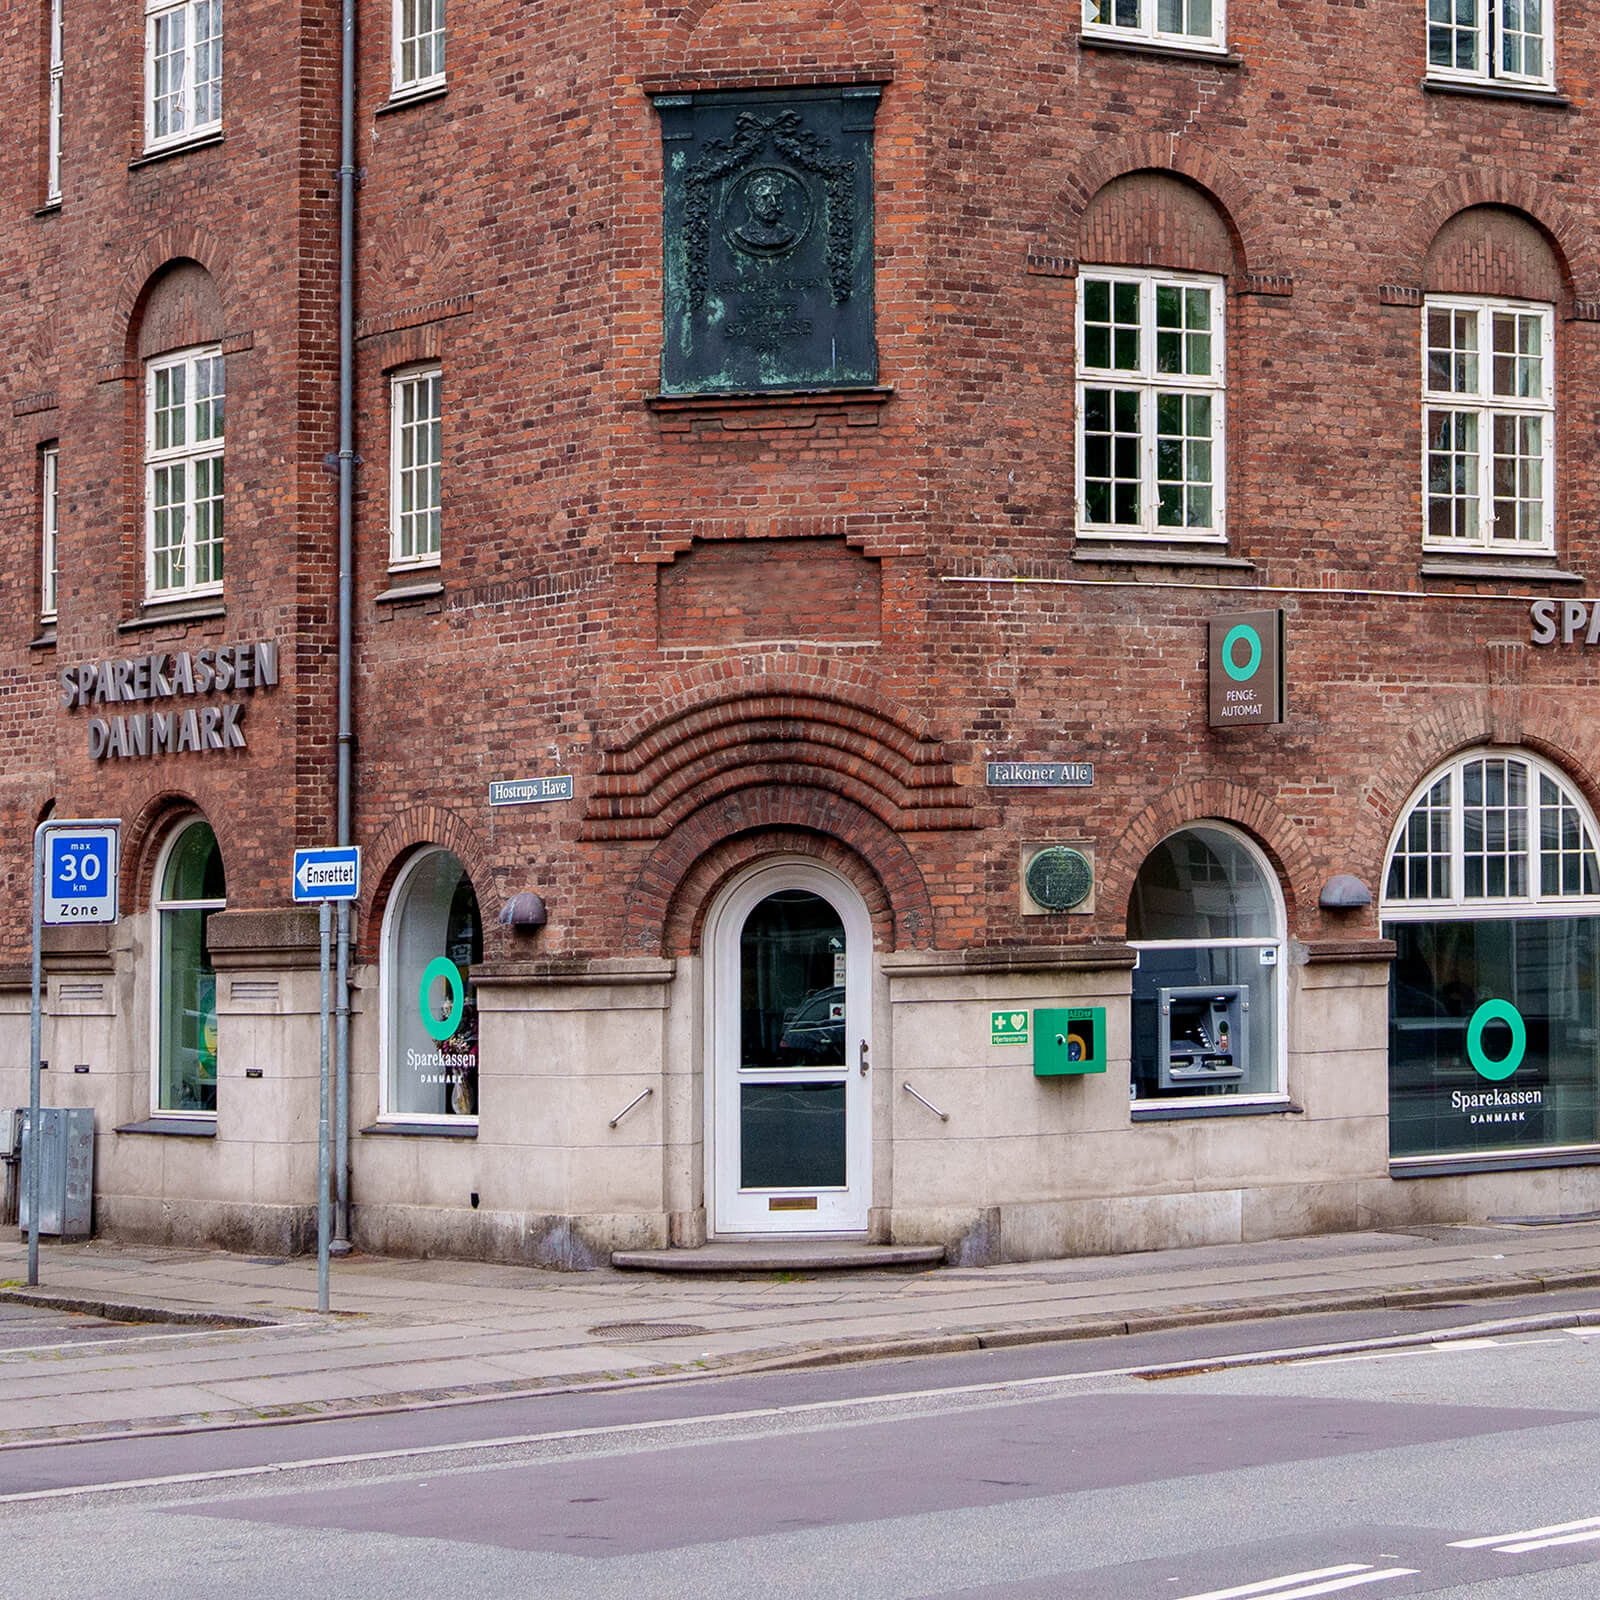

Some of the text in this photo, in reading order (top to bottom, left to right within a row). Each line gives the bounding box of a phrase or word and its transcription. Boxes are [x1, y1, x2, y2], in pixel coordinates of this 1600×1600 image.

[60, 641, 279, 708] SPAREKASSEN
[1226, 689, 1257, 702] PENGE-
[1221, 704, 1263, 717] AUTOMAT
[88, 703, 247, 760] DANMARK
[994, 764, 1055, 780] Falkoner
[495, 780, 567, 800] Hostrups Have
[59, 853, 101, 882] 30
[307, 865, 353, 884] Ensrettet
[72, 883, 87, 892] km
[60, 904, 98, 917] Zone
[407, 1048, 476, 1071] Sparekassen
[420, 1074, 463, 1084] DANMARK
[1451, 1088, 1542, 1113] Sparekassen
[1470, 1111, 1526, 1124] DANMARK
